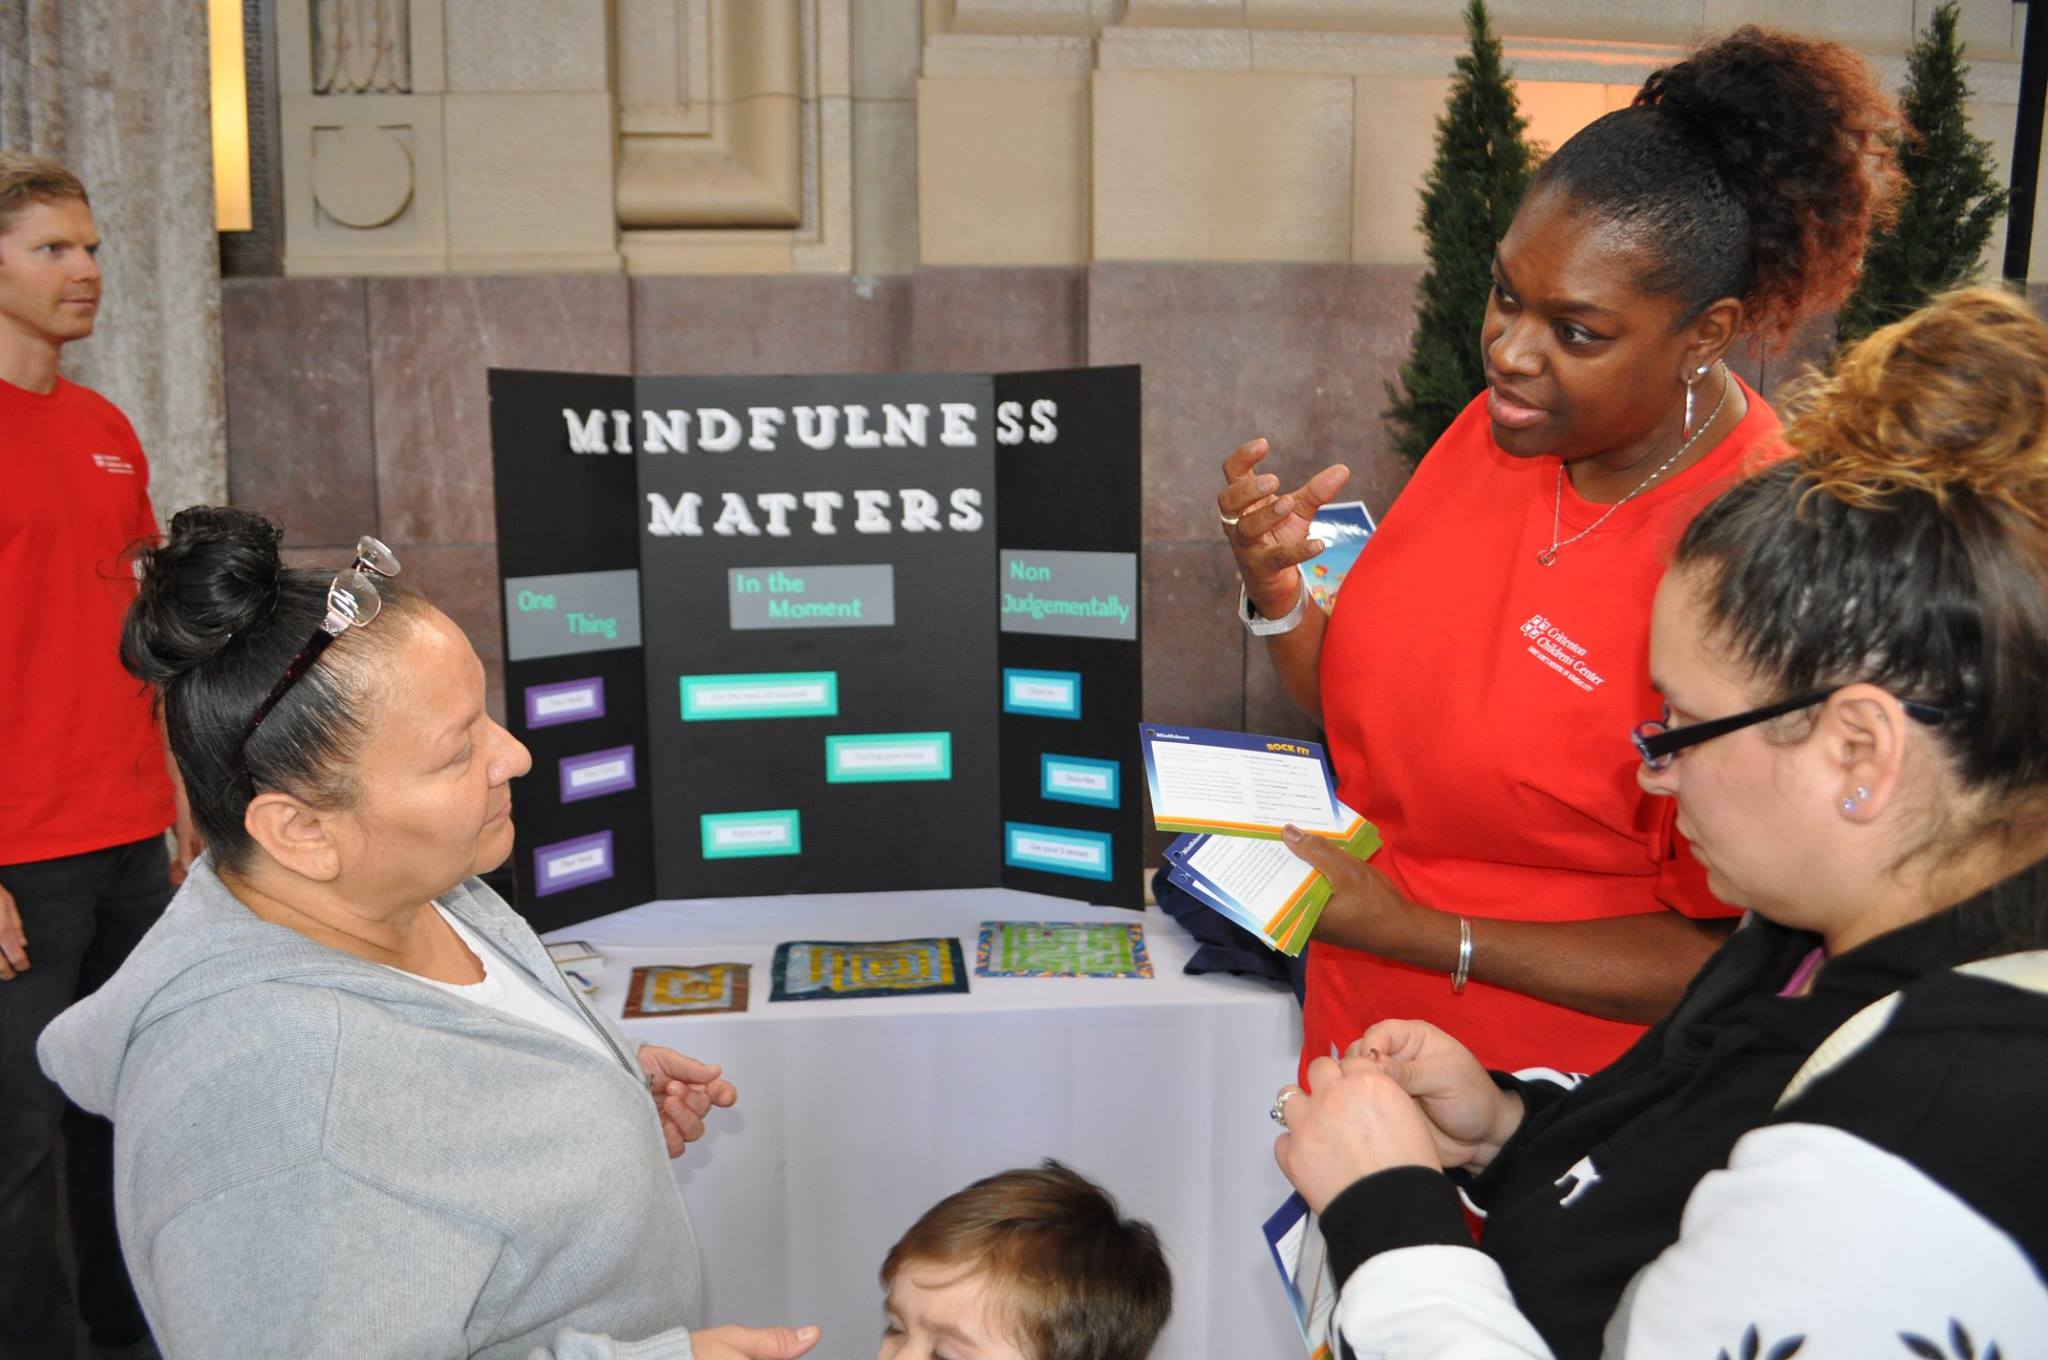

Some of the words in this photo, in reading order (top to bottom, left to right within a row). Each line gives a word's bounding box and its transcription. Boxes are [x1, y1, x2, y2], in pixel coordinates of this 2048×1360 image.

[563, 399, 1058, 455] MINDFULNESS
[647, 487, 984, 536] MATTERS
[736, 573, 761, 593] In
[768, 571, 806, 594] the
[1010, 560, 1051, 581] Non
[517, 589, 556, 612] One
[768, 597, 863, 619] Moment
[1001, 592, 1131, 625] Judgementally
[566, 611, 618, 640] Thing
[1573, 660, 1604, 686] Center
[1265, 743, 1296, 753] ROCK
